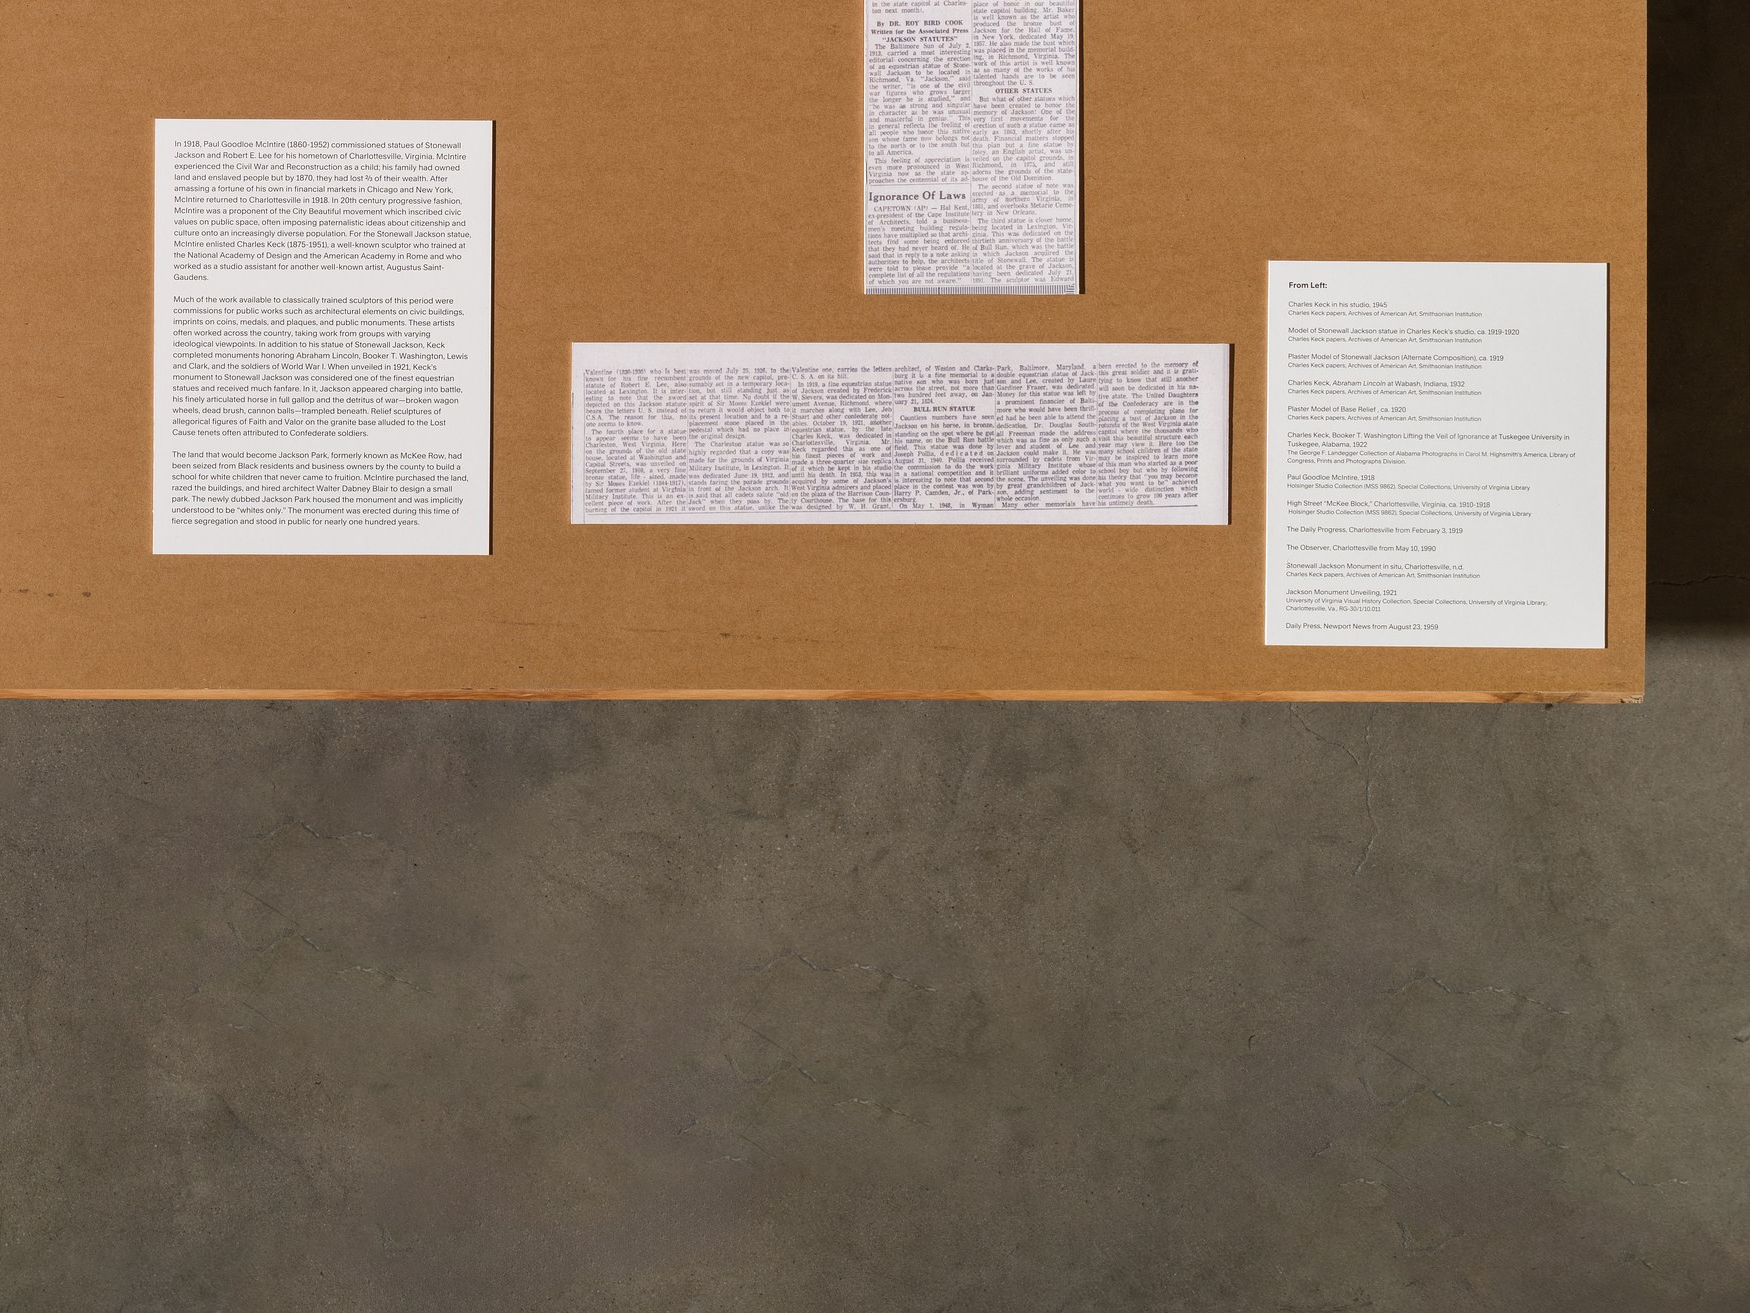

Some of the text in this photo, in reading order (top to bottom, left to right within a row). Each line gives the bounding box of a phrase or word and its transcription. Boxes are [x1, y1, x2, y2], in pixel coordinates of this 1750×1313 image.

[184, 140, 202, 148] 1918,
[203, 140, 220, 148] Paul
[221, 140, 254, 148] Goodloe
[287, 140, 330, 149] (1860-1952)
[331, 141, 386, 149] commissioned
[416, 141, 424, 149] of
[425, 141, 462, 149] Stonewall
[174, 151, 206, 159] Jackson
[223, 151, 248, 159] Robert
[286, 152, 297, 160] his
[298, 152, 339, 160] hometown
[339, 152, 348, 160] of
[349, 152, 404, 160] Charlottesville,
[405, 153, 435, 162] Virginia.
[436, 153, 467, 161] McIntire
[869, 190, 966, 203] Ignorance Of Laws
[1289, 281, 1309, 289] From
[1450, 380, 1466, 388] 1932
[172, 428, 196, 436] Cause
[222, 429, 242, 437] often
[289, 429, 337, 437] Confederate
[194, 518, 239, 527] segregation
[287, 518, 311, 526] public
[324, 518, 348, 527] nearly
[364, 518, 397, 526] hundred
[1413, 623, 1423, 631] 23,
